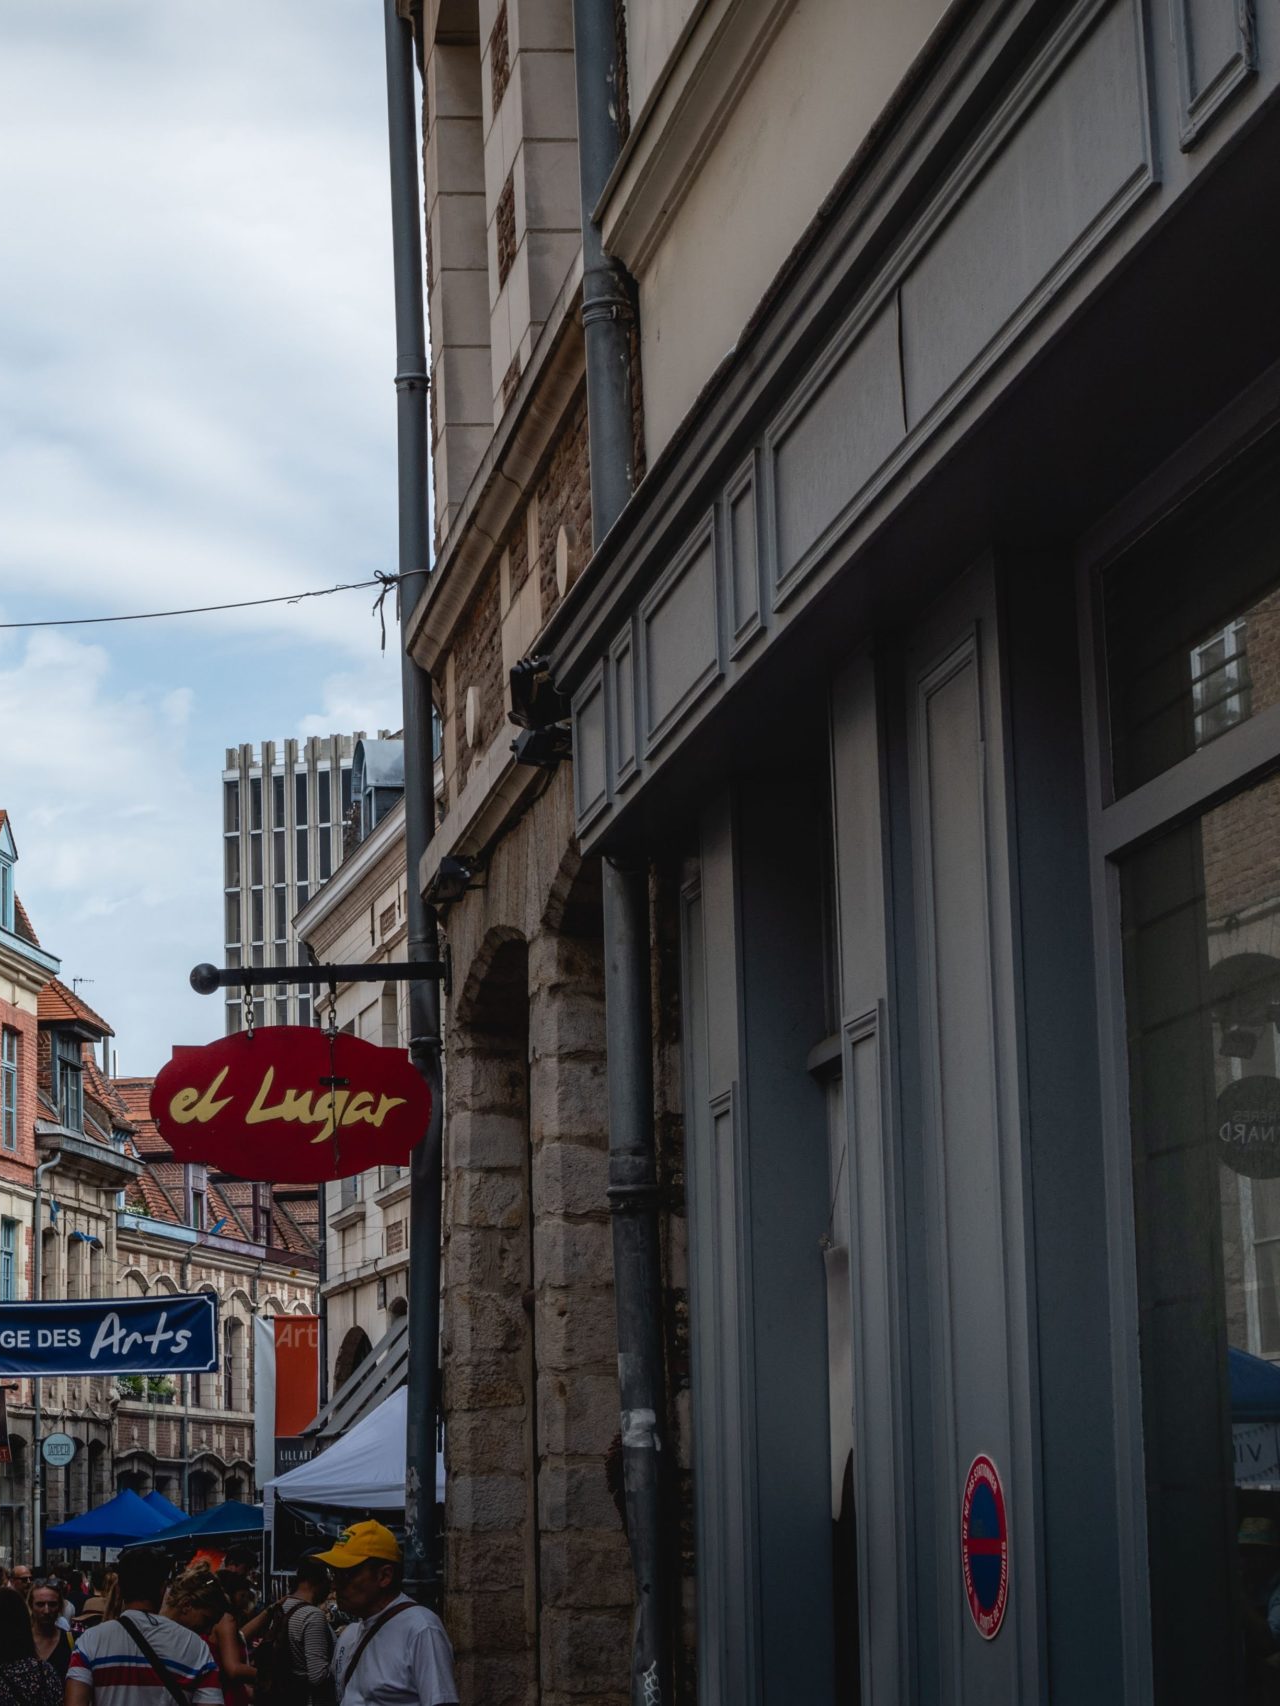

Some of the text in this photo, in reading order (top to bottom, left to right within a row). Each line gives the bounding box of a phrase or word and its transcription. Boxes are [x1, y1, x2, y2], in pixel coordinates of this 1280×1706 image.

[169, 1065, 407, 1144] el Lugar
[37, 1328, 82, 1348] DES
[90, 1311, 193, 1360] Arts
